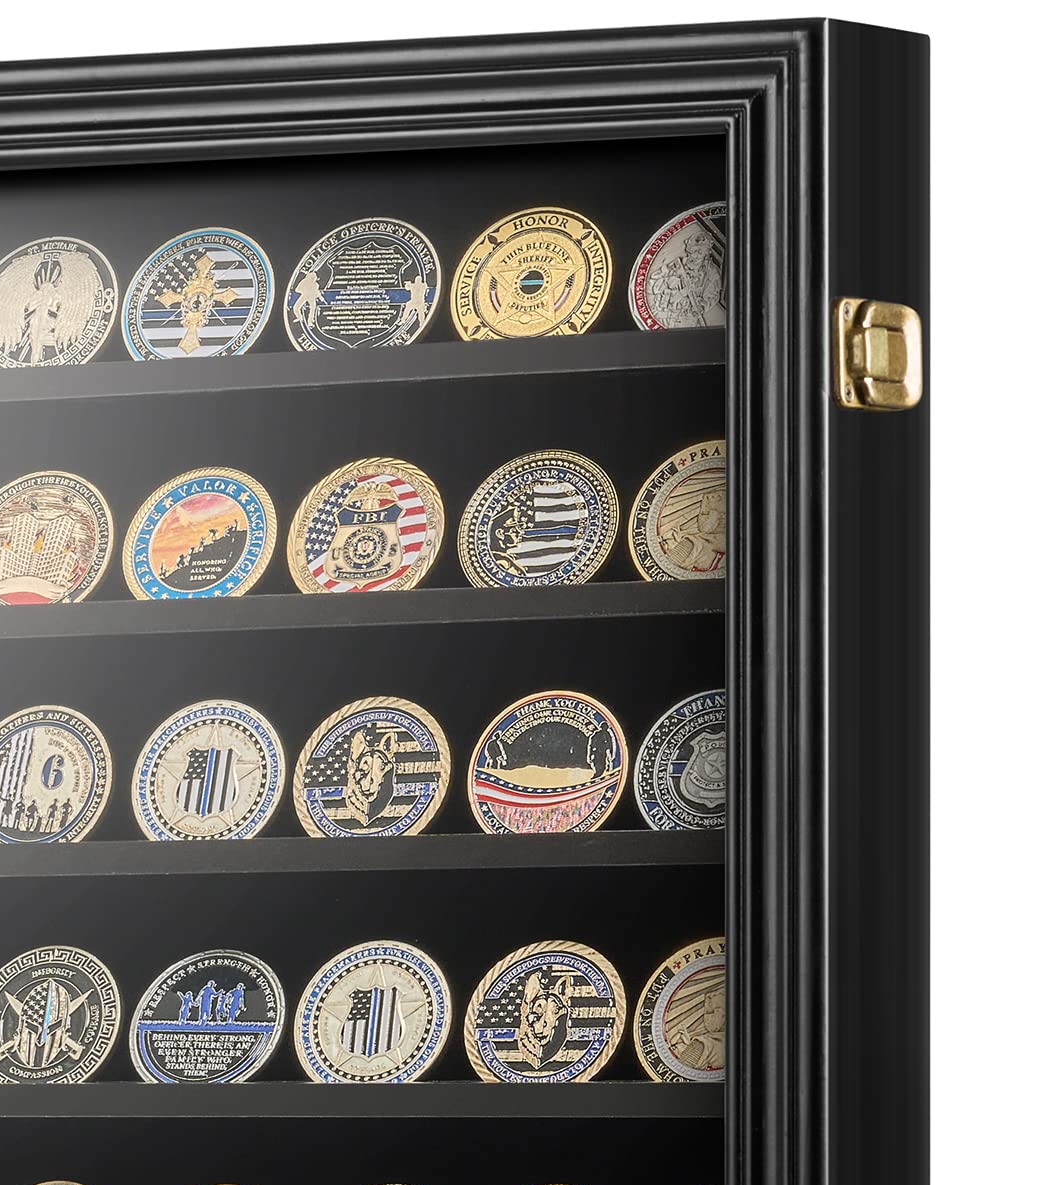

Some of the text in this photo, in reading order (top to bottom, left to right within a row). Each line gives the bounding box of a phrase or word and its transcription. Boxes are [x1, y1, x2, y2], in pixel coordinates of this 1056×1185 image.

[513, 217, 569, 231] HONOR
[302, 234, 338, 274] POLICE
[403, 231, 436, 275] PRAYER
[502, 242, 570, 265] THIN BLUE LINE
[518, 256, 555, 264] SHERIFF
[461, 256, 482, 316] SERVICE
[579, 240, 605, 320] INTEGRITY
[179, 479, 238, 498] VALOR
[352, 511, 388, 524] FBI
[134, 512, 162, 583] SERVICE
[234, 503, 265, 580] SACRIFICE
[46, 712, 70, 722] AND
[514, 698, 597, 718] THANK YOU FOR
[41, 754, 64, 789] 6
